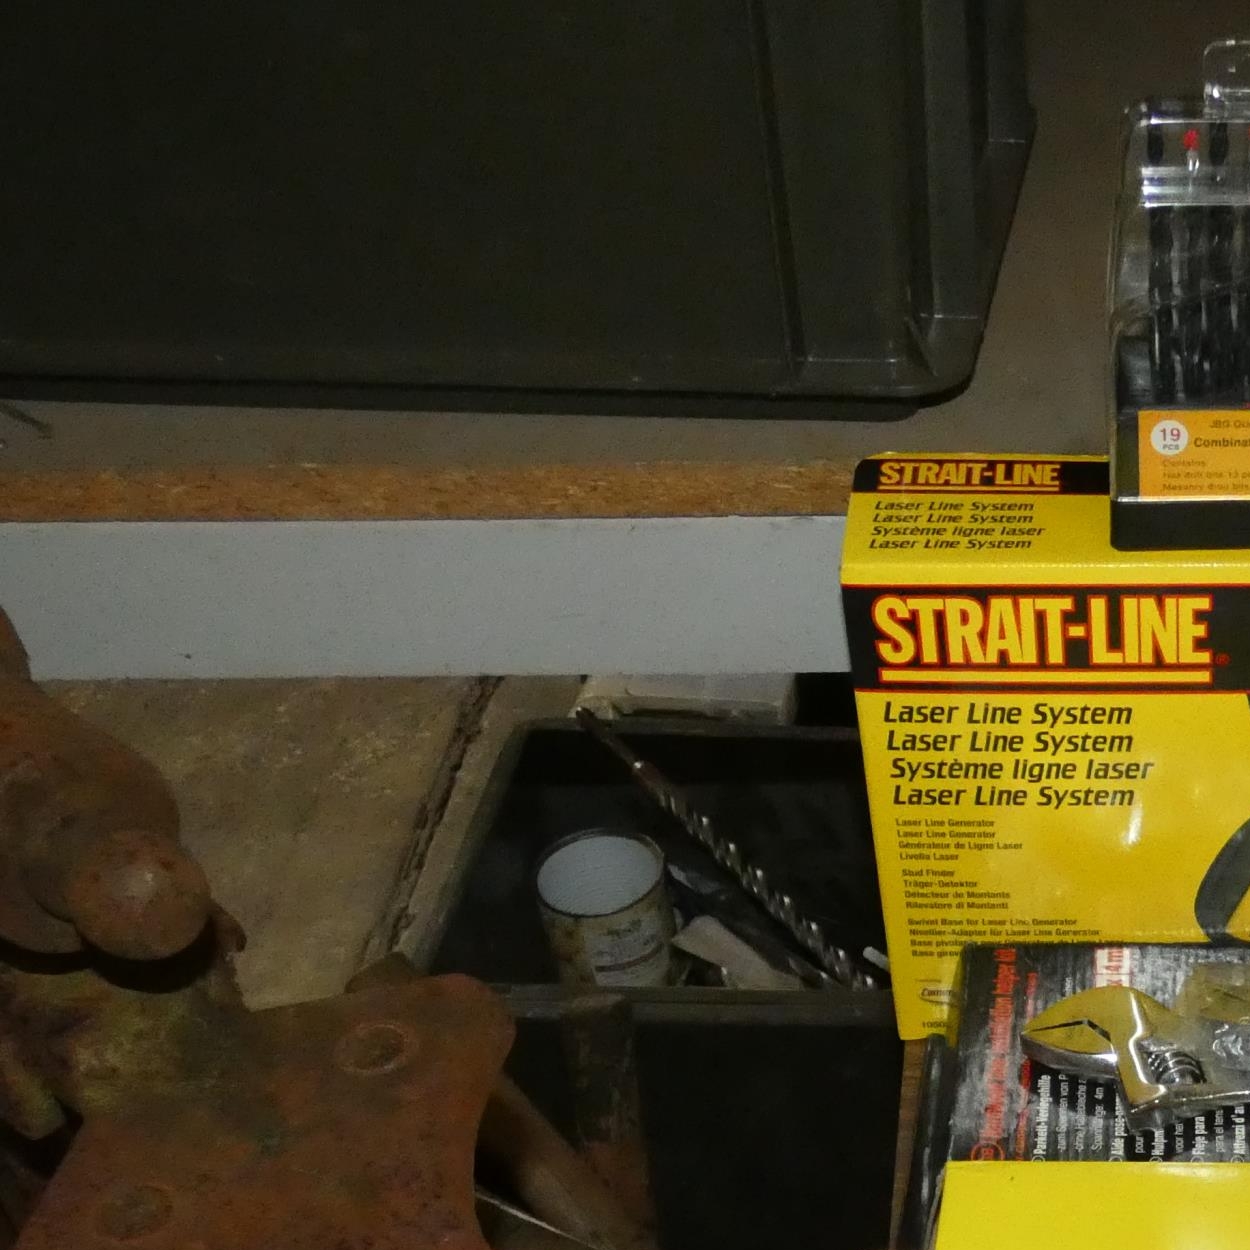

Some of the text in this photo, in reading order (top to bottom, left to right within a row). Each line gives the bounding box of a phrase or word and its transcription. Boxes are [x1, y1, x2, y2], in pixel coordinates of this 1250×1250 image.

[1159, 427, 1181, 442] 19
[880, 462, 1060, 487] STRAIT-LINE
[872, 513, 1033, 525] Laser Line System
[875, 501, 1034, 513] Laser Line System
[871, 525, 1045, 537] Système ligne laser
[869, 538, 1032, 551] Laser Line System
[872, 594, 1214, 666] STRAIT-LINE
[884, 702, 1133, 729] Laser Line System
[887, 731, 1133, 757] Laser Line System
[890, 758, 1154, 783] Système ligne laser
[893, 785, 1135, 810] Laser Line System
[1094, 1087, 1105, 1100] 4m
[1033, 1075, 1053, 1155] Parkett-Verlegehilfe
[1111, 1137, 1125, 1155] Aide
[1135, 1136, 1146, 1154] pour
[1175, 1137, 1184, 1154] voor
[1192, 1116, 1208, 1155] Fleje para
[1214, 1126, 1225, 1153] para el
[1232, 1124, 1245, 1155] Attrezzi
